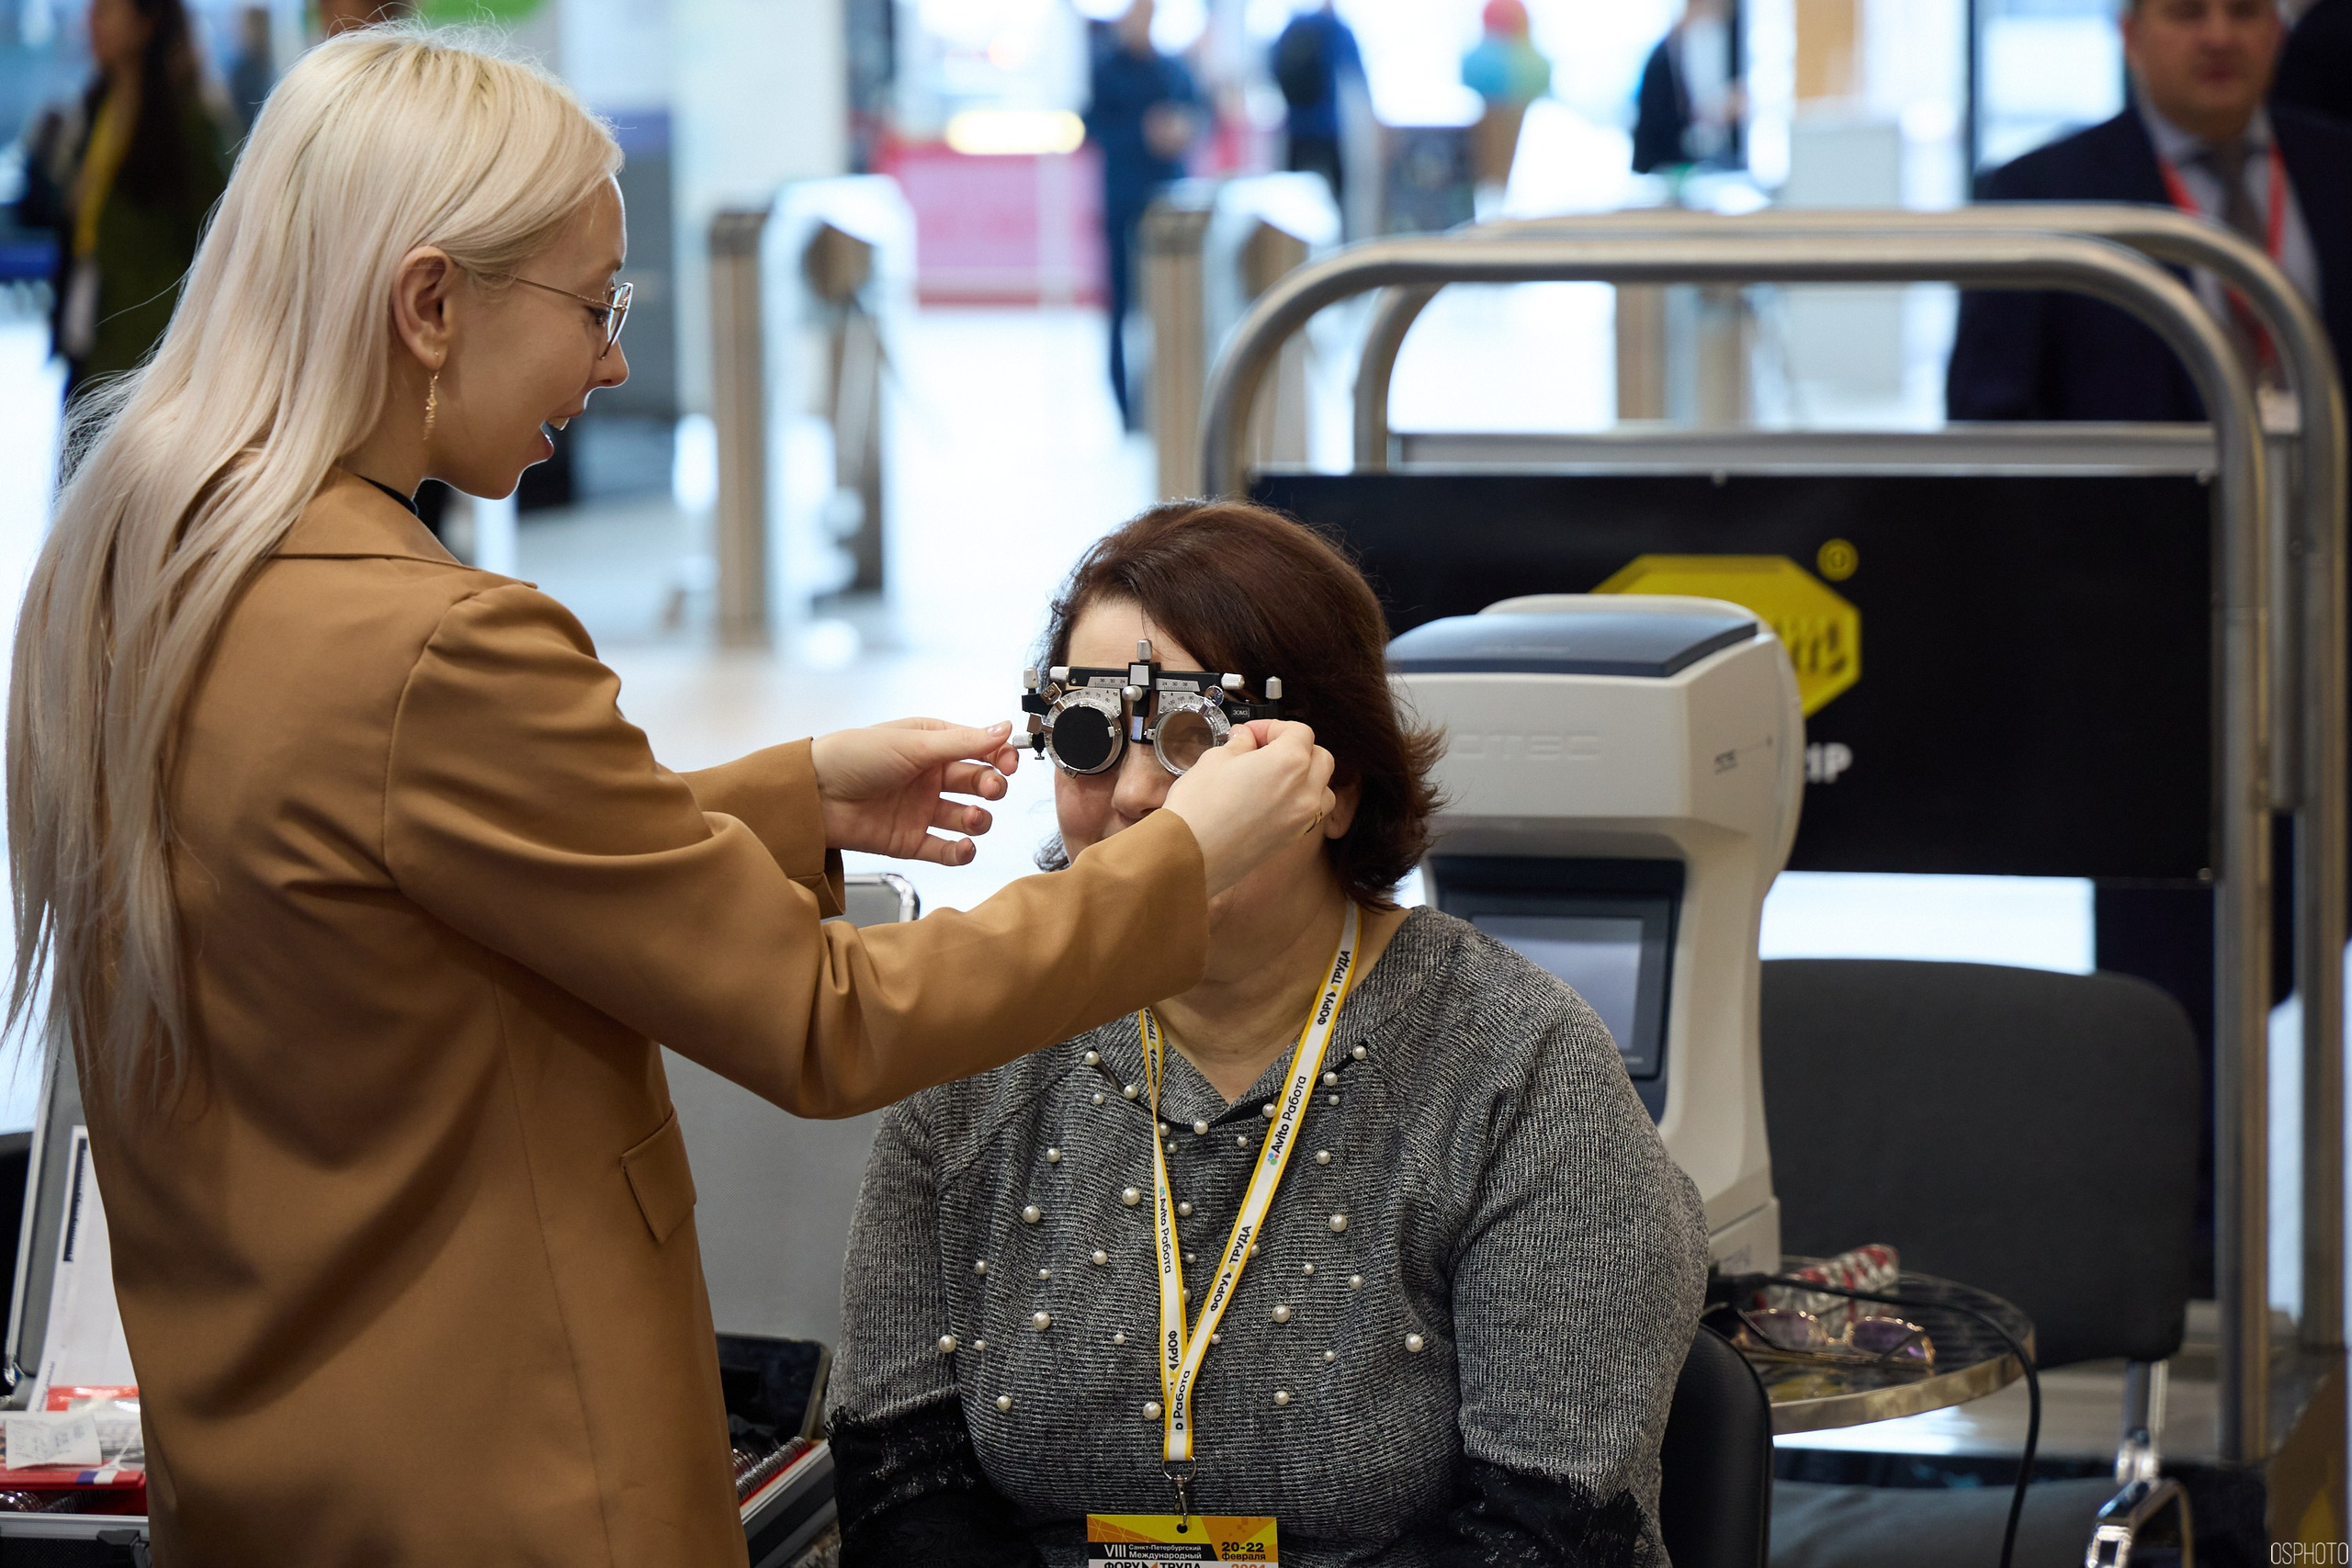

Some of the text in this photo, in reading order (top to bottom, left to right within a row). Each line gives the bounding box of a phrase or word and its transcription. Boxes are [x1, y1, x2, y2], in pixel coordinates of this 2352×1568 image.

[1331, 951, 1351, 984] ТРУДА
[1272, 1076, 1306, 1154] Avito Работа
[1159, 1198, 1171, 1274] Avito Работа
[1228, 1225, 1252, 1263] ТРУДА
[1173, 1371, 1191, 1418] Работа
[1103, 1544, 1126, 1558] VIII
[1128, 1544, 1202, 1552] Санкт-Петербургский
[1128, 1551, 1202, 1560] Международный
[1221, 1541, 1265, 1552] 20-22
[1221, 1551, 1266, 1562] февраля
